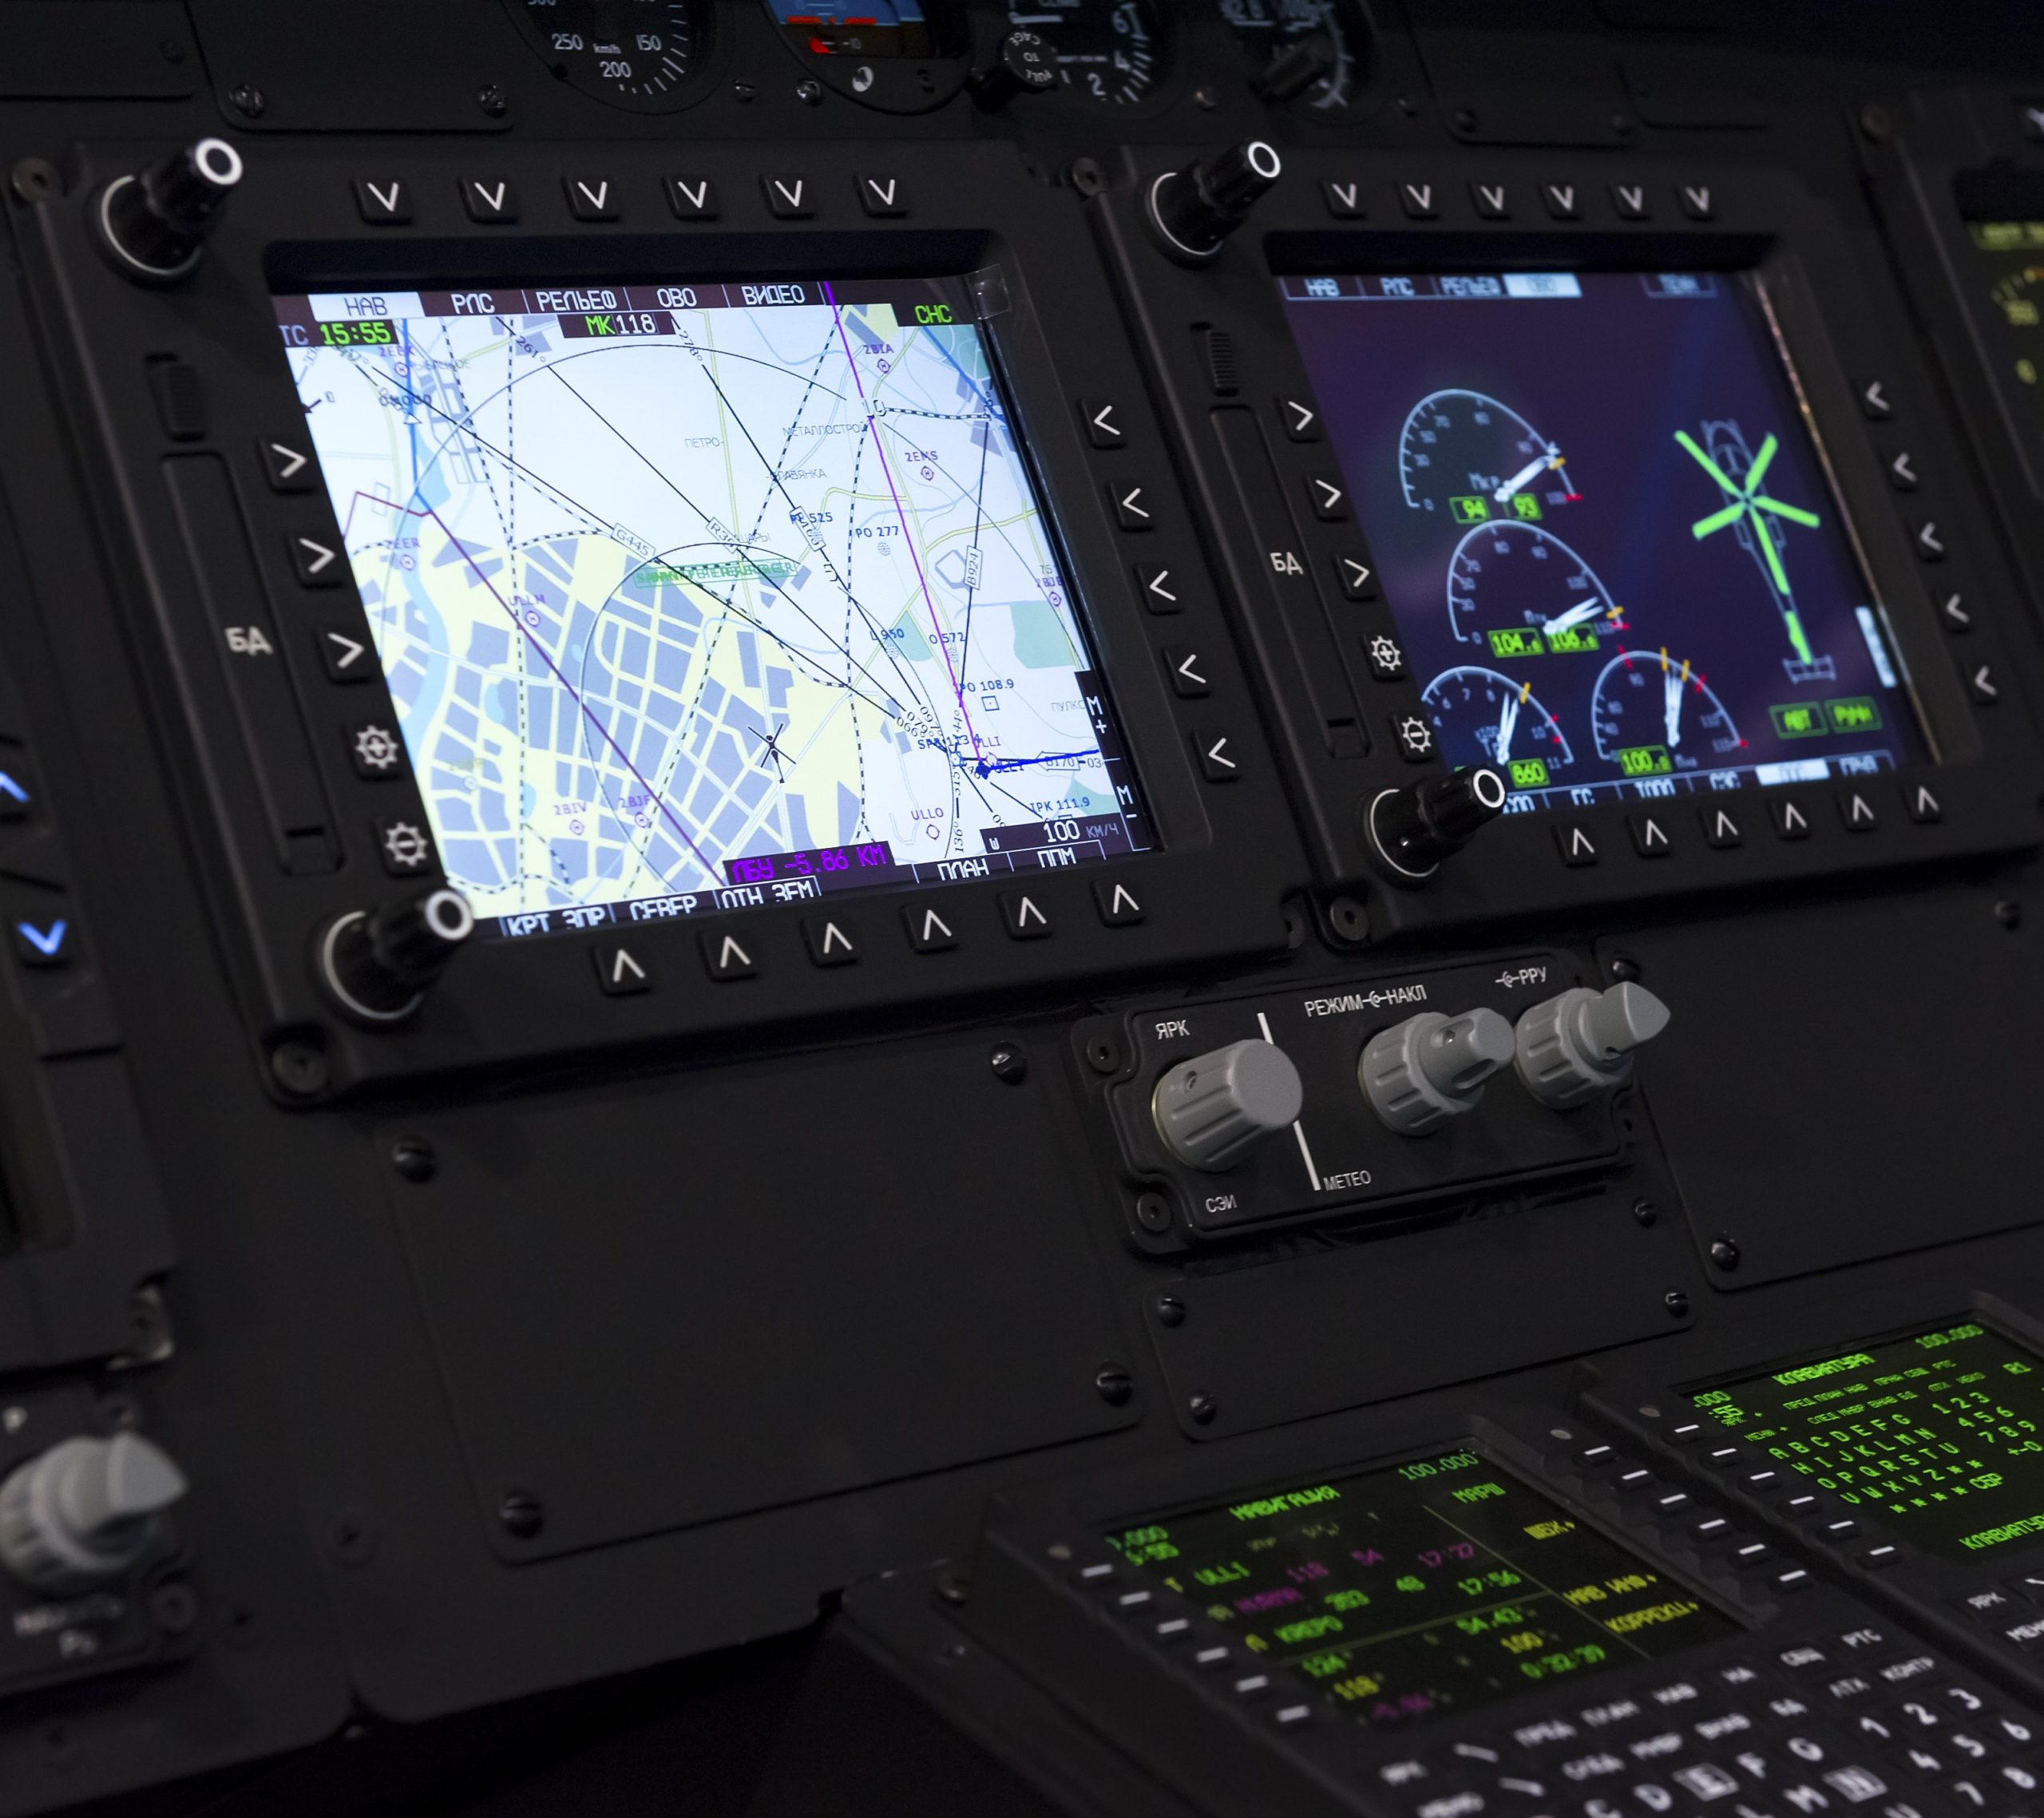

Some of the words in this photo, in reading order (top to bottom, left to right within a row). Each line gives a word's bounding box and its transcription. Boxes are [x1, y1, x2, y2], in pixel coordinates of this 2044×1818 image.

[1112, 11, 1128, 34] 6
[552, 33, 583, 50] 250
[636, 34, 661, 51] 150
[1024, 52, 1040, 62] TO
[600, 61, 632, 77] 200
[1087, 73, 1106, 96] 2
[450, 293, 495, 315] РЛС
[536, 290, 617, 311] РЕЛЬЕФ
[656, 287, 697, 308] ОВО
[741, 284, 806, 306] ВИДЕО
[343, 296, 388, 317] НАВ
[914, 305, 953, 324] СНС
[319, 322, 391, 345] 15:55
[1462, 499, 1487, 519] 94
[616, 529, 651, 556] G445
[856, 527, 872, 538] PO
[878, 525, 899, 537] 277
[968, 551, 979, 585] B924
[980, 679, 1015, 691] 108.9
[1512, 762, 1546, 784] 860
[911, 807, 945, 820] ULLO
[1058, 797, 1090, 810] 111.9
[1044, 820, 1080, 842] 100
[1086, 822, 1119, 838] КМ/Ч
[784, 849, 850, 875] -5.86
[857, 843, 887, 866] КМ
[1037, 847, 1077, 868] ППМ
[937, 858, 990, 881] ПЛАН
[506, 914, 549, 937] КРТ
[1518, 967, 1547, 986] РРУ
[1304, 994, 1364, 1018] РЕЖИМ
[1385, 984, 1428, 1006] НАКЛ
[1155, 1020, 1190, 1040] ЯРК
[1323, 1169, 1373, 1191] МЕТЕО
[1206, 1194, 1238, 1214] СЭИ
[1771, 1353, 1876, 1386] КЛАВИАТУРА
[1932, 1403, 1952, 1414] 1
[1950, 1397, 1972, 1409] 2
[1969, 1392, 1991, 1404] 3
[1958, 1416, 1976, 1428] 4
[1972, 1411, 1995, 1423] 5
[1996, 1406, 2015, 1418] 6
[1768, 1448, 1791, 1460] A
[1788, 1440, 1812, 1454] B
[1810, 1436, 1832, 1448] C
[1828, 1430, 1851, 1443] D
[1849, 1424, 1873, 1436] E
[1869, 1418, 1888, 1431] F
[1891, 1413, 1911, 1425] G
[1978, 1431, 1995, 1444] 7
[1998, 1425, 2020, 1437] 8
[2017, 1420, 2037, 1432] 9
[1790, 1462, 1816, 1475] H
[1814, 1456, 1834, 1468] I
[1838, 1450, 1855, 1462] J
[1852, 1444, 1876, 1456] K
[1873, 1440, 1897, 1452] L
[1893, 1433, 1918, 1445] M
[1913, 1428, 1938, 1440] N
[1399, 1453, 1479, 1480] 100.000
[1817, 1477, 1838, 1489] O
[1836, 1471, 1854, 1483] P
[1858, 1465, 1882, 1477] Q
[1877, 1460, 1902, 1472] R
[1898, 1454, 1920, 1466] S
[1918, 1448, 1939, 1460] T
[1938, 1442, 1960, 1454] U
[1452, 1482, 1506, 1503] МАРШ
[1840, 1491, 1861, 1504] V
[1860, 1486, 1884, 1499] W
[1881, 1480, 1906, 1493] X
[1902, 1475, 1923, 1486] Y
[1922, 1468, 1946, 1481] Z
[1860, 1717, 1891, 1739] 1
[1903, 1701, 1939, 1725] 2
[1948, 1688, 1983, 1710] 3
[1951, 1733, 1987, 1757] 5
[1999, 1719, 2032, 1741] 6
[1954, 1780, 1986, 1806] 7
[2002, 1766, 2037, 1790] 8
